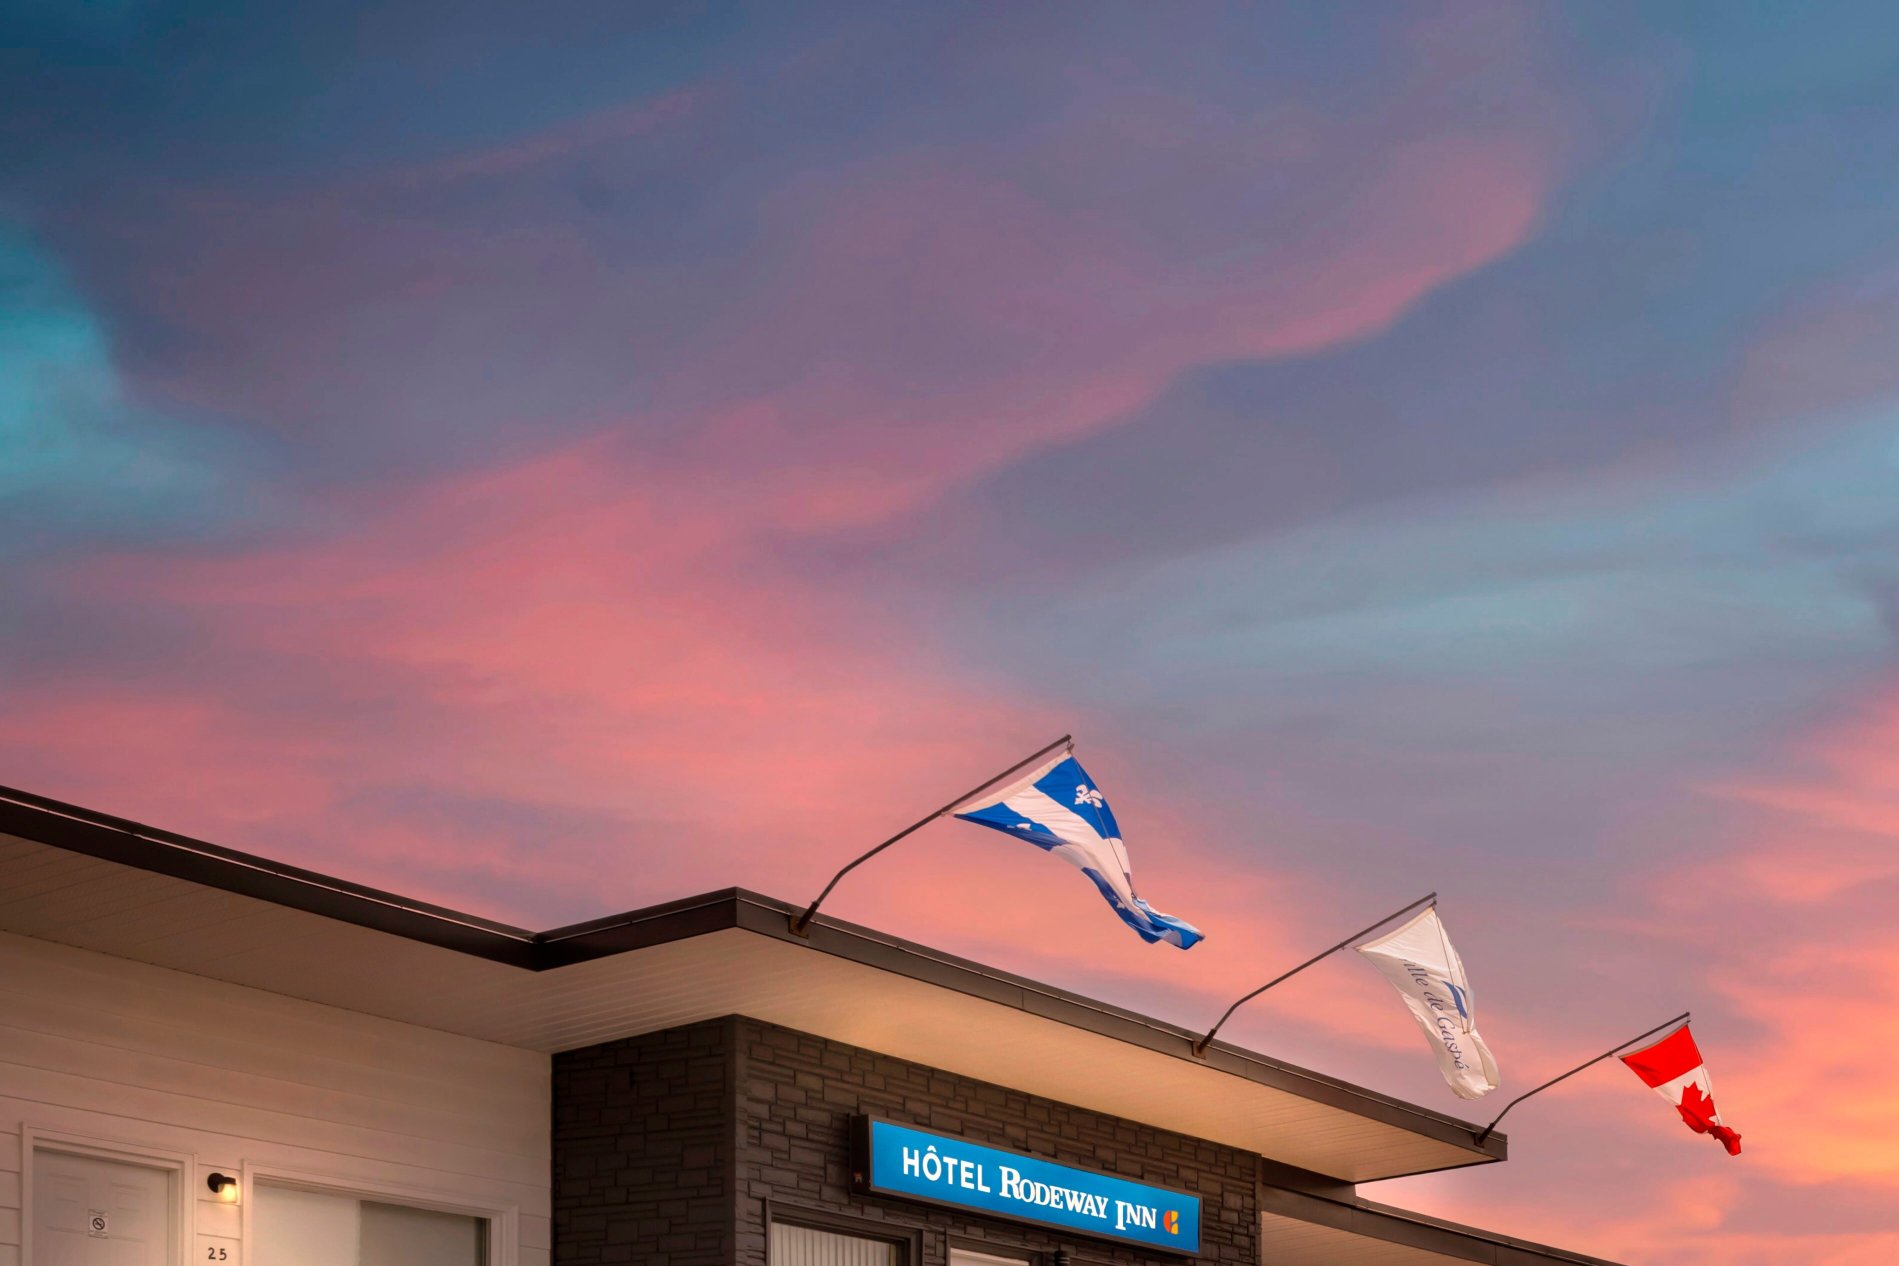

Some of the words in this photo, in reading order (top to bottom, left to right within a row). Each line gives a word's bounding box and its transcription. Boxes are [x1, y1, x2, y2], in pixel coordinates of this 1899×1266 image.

[1423, 991, 1444, 1011] de
[1437, 1017, 1470, 1070] Gaspé
[902, 1145, 990, 1193] HÔTEL
[999, 1165, 1108, 1219] RODEWAY
[1114, 1200, 1157, 1231] INN
[208, 1247, 227, 1261] 25
